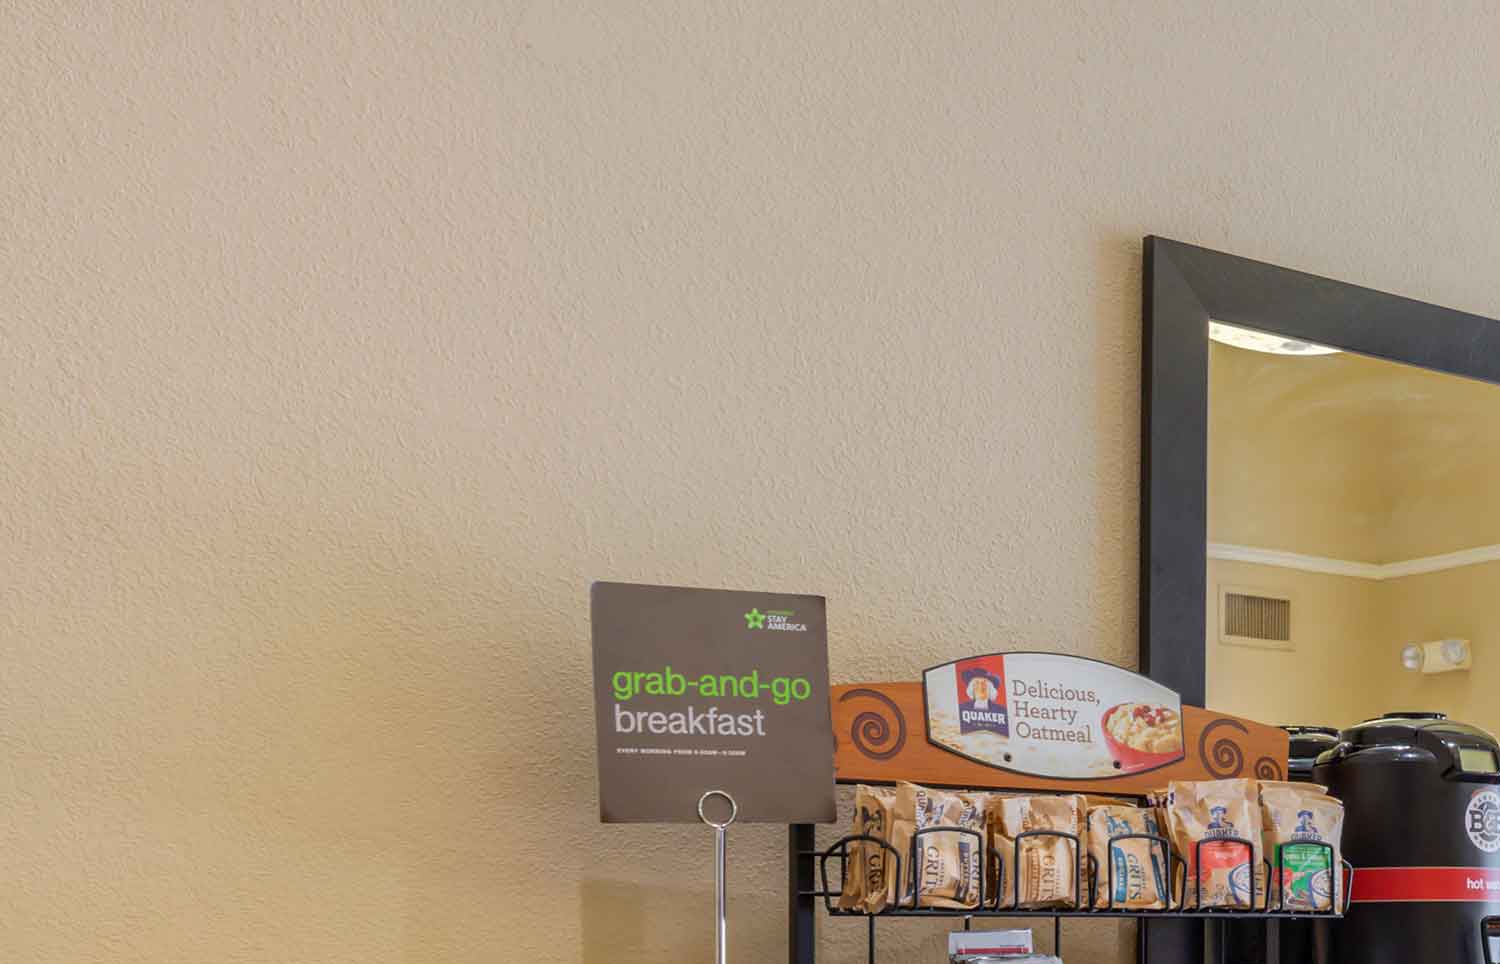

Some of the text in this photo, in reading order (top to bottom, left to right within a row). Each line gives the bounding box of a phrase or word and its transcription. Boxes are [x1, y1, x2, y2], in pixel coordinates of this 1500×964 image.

[612, 666, 811, 705] grab-and-go
[1012, 680, 1101, 706] Delicious,
[614, 704, 766, 736] breakfast
[962, 710, 1007, 724] QUAKER
[1014, 700, 1078, 725] Hearty
[1016, 721, 1093, 744] Oatmeal
[1466, 877, 1484, 890] hot
